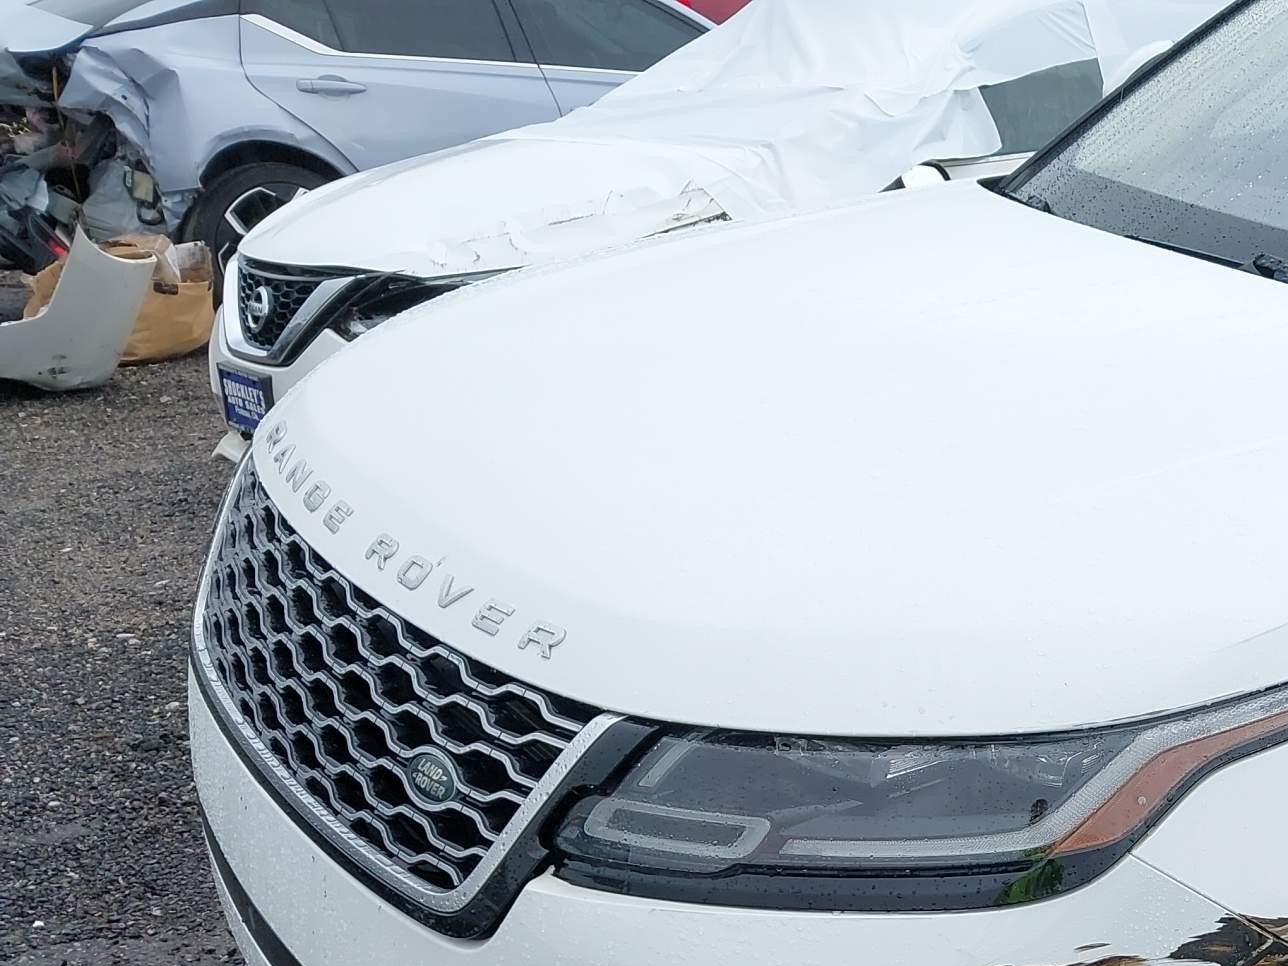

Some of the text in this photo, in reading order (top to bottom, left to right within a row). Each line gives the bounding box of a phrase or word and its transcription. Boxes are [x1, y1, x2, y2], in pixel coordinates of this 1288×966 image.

[223, 378, 265, 409] SHOCKLEY'S
[228, 396, 243, 407] AUTO
[266, 420, 567, 660] RANGE ROVER
[417, 758, 443, 780] LAND
[414, 772, 446, 799] ROVER
